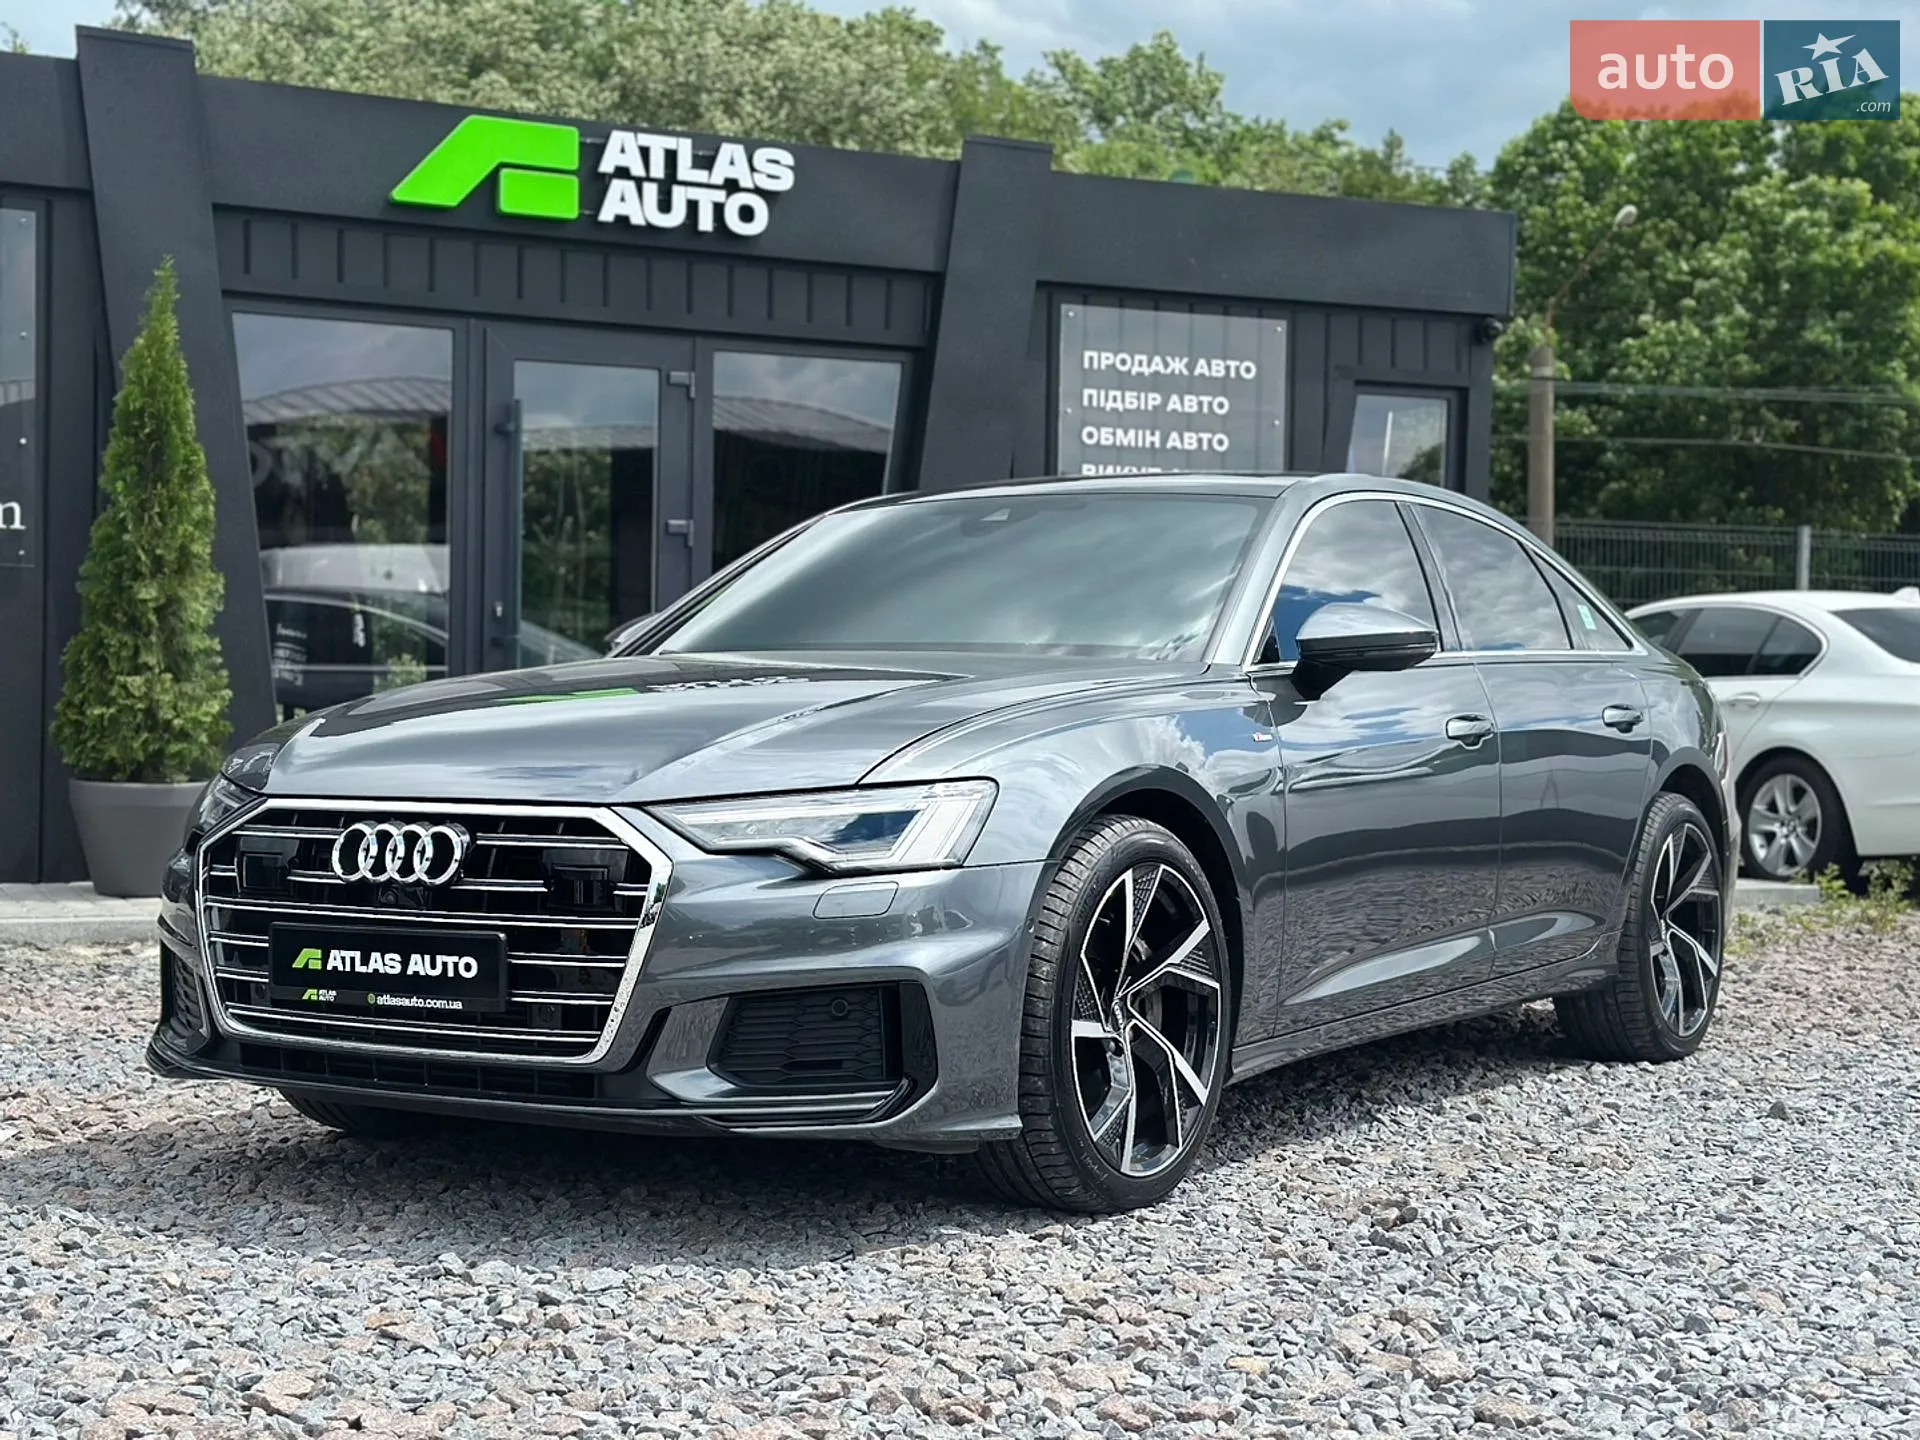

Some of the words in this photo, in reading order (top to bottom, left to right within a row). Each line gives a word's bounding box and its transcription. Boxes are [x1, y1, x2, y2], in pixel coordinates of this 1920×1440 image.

[597, 129, 795, 192] ATLAS
[597, 178, 770, 236] AUTO
[1082, 350, 1189, 377] ПРОДАЖ
[1193, 357, 1257, 380] АВТО
[1082, 388, 1162, 412] ПІДБІР
[1166, 394, 1230, 416] АВТО
[1081, 425, 1161, 449] ОБМІН
[1166, 431, 1230, 452] АВТО
[326, 949, 402, 975] ATLAS
[406, 954, 479, 979] AUTO
[377, 994, 463, 1009] atlasauto.com.ua
